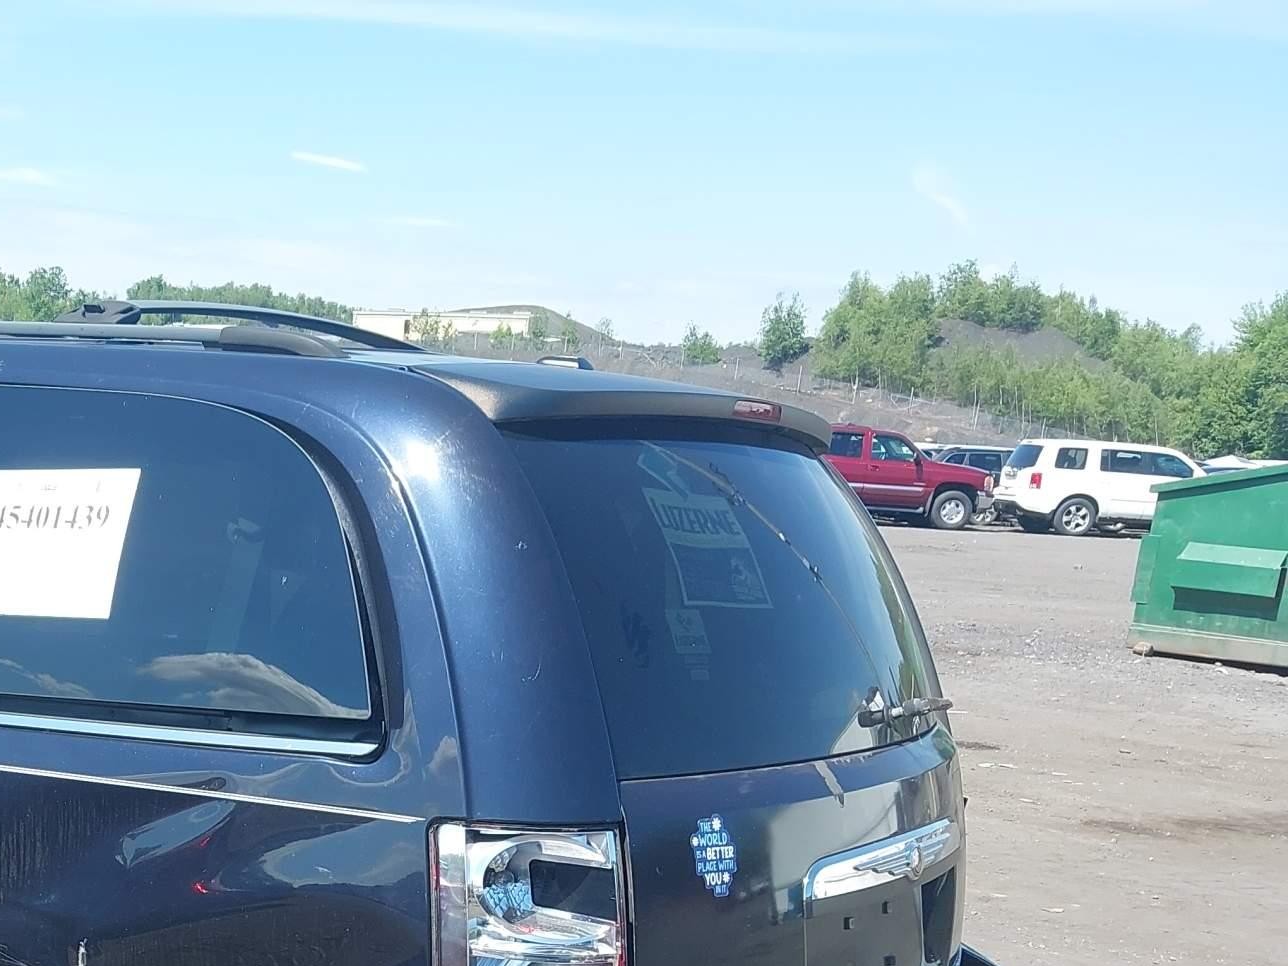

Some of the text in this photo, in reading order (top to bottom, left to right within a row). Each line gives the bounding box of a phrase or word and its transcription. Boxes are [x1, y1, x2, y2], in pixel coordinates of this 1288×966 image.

[700, 822, 712, 832] THE
[699, 833, 727, 847] WORLD
[706, 846, 734, 860] BETTER
[697, 860, 734, 872] PLACE WITH
[704, 872, 722, 885] YOU
